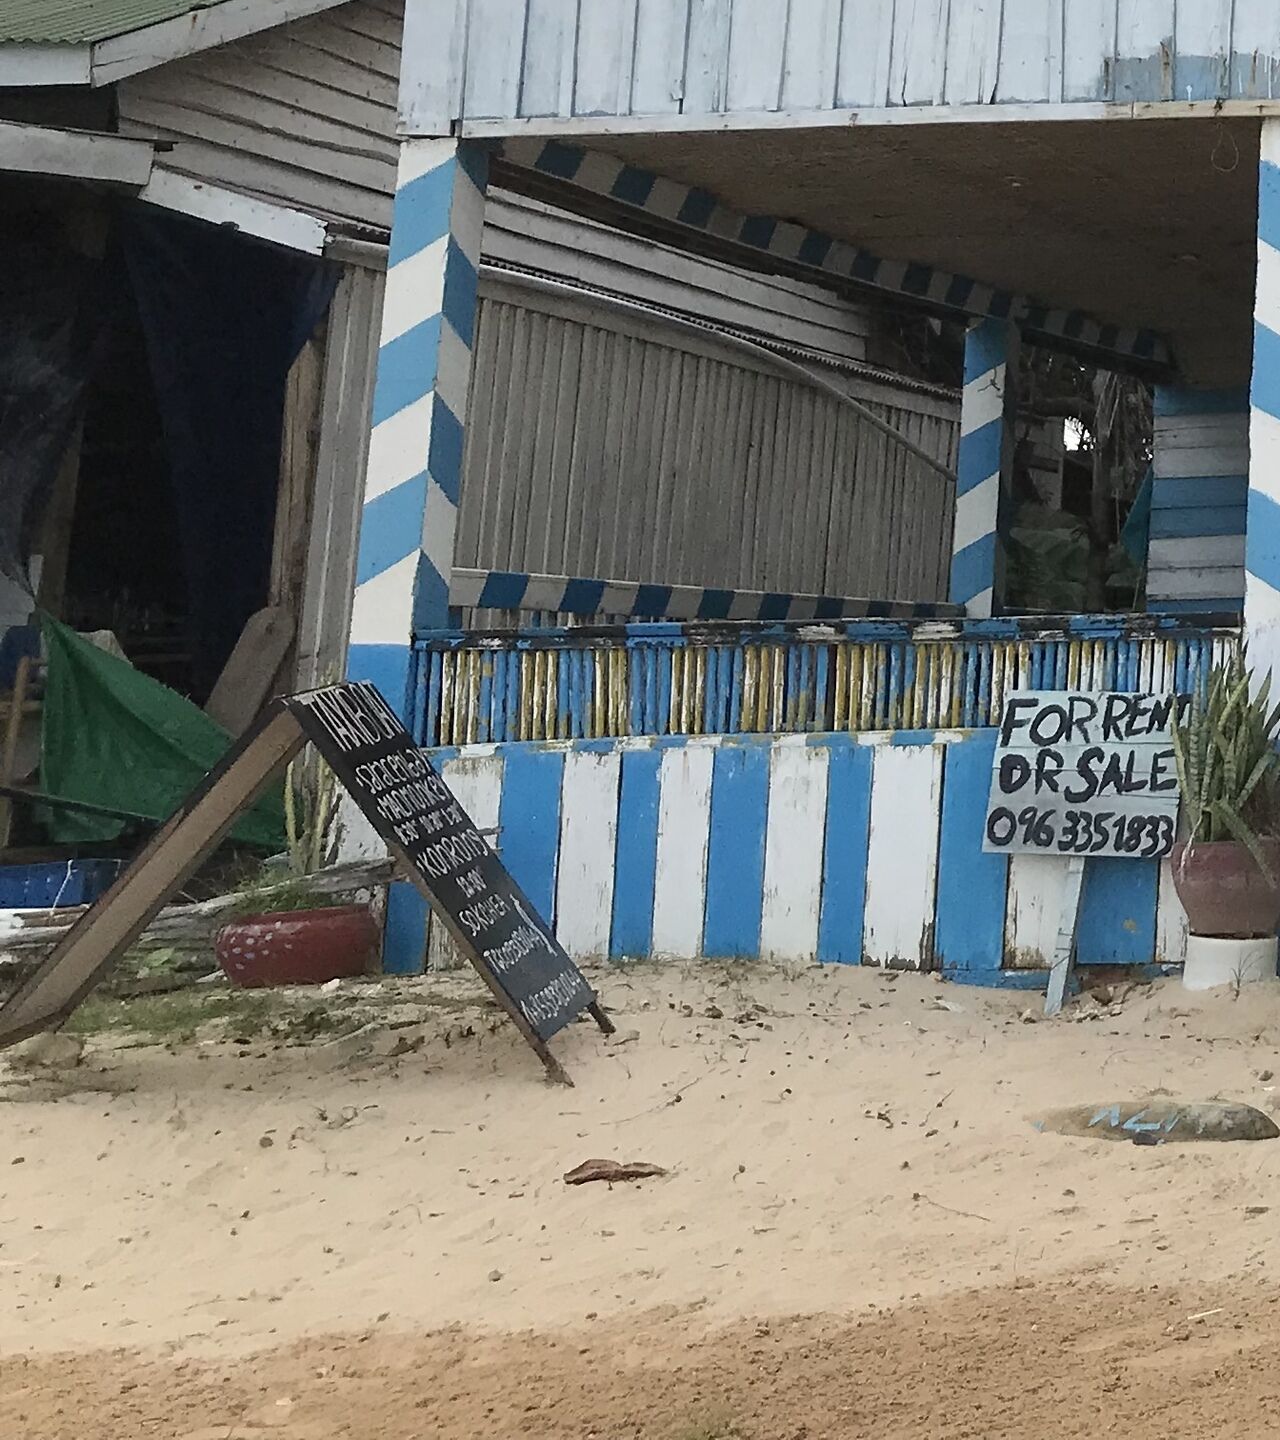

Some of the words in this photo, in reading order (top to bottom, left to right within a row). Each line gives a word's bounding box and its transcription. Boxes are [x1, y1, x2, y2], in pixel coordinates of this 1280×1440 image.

[1000, 696, 1098, 747] FOR
[1102, 693, 1192, 742] RENT
[998, 747, 1065, 795] OR
[1065, 747, 1178, 804] SALE
